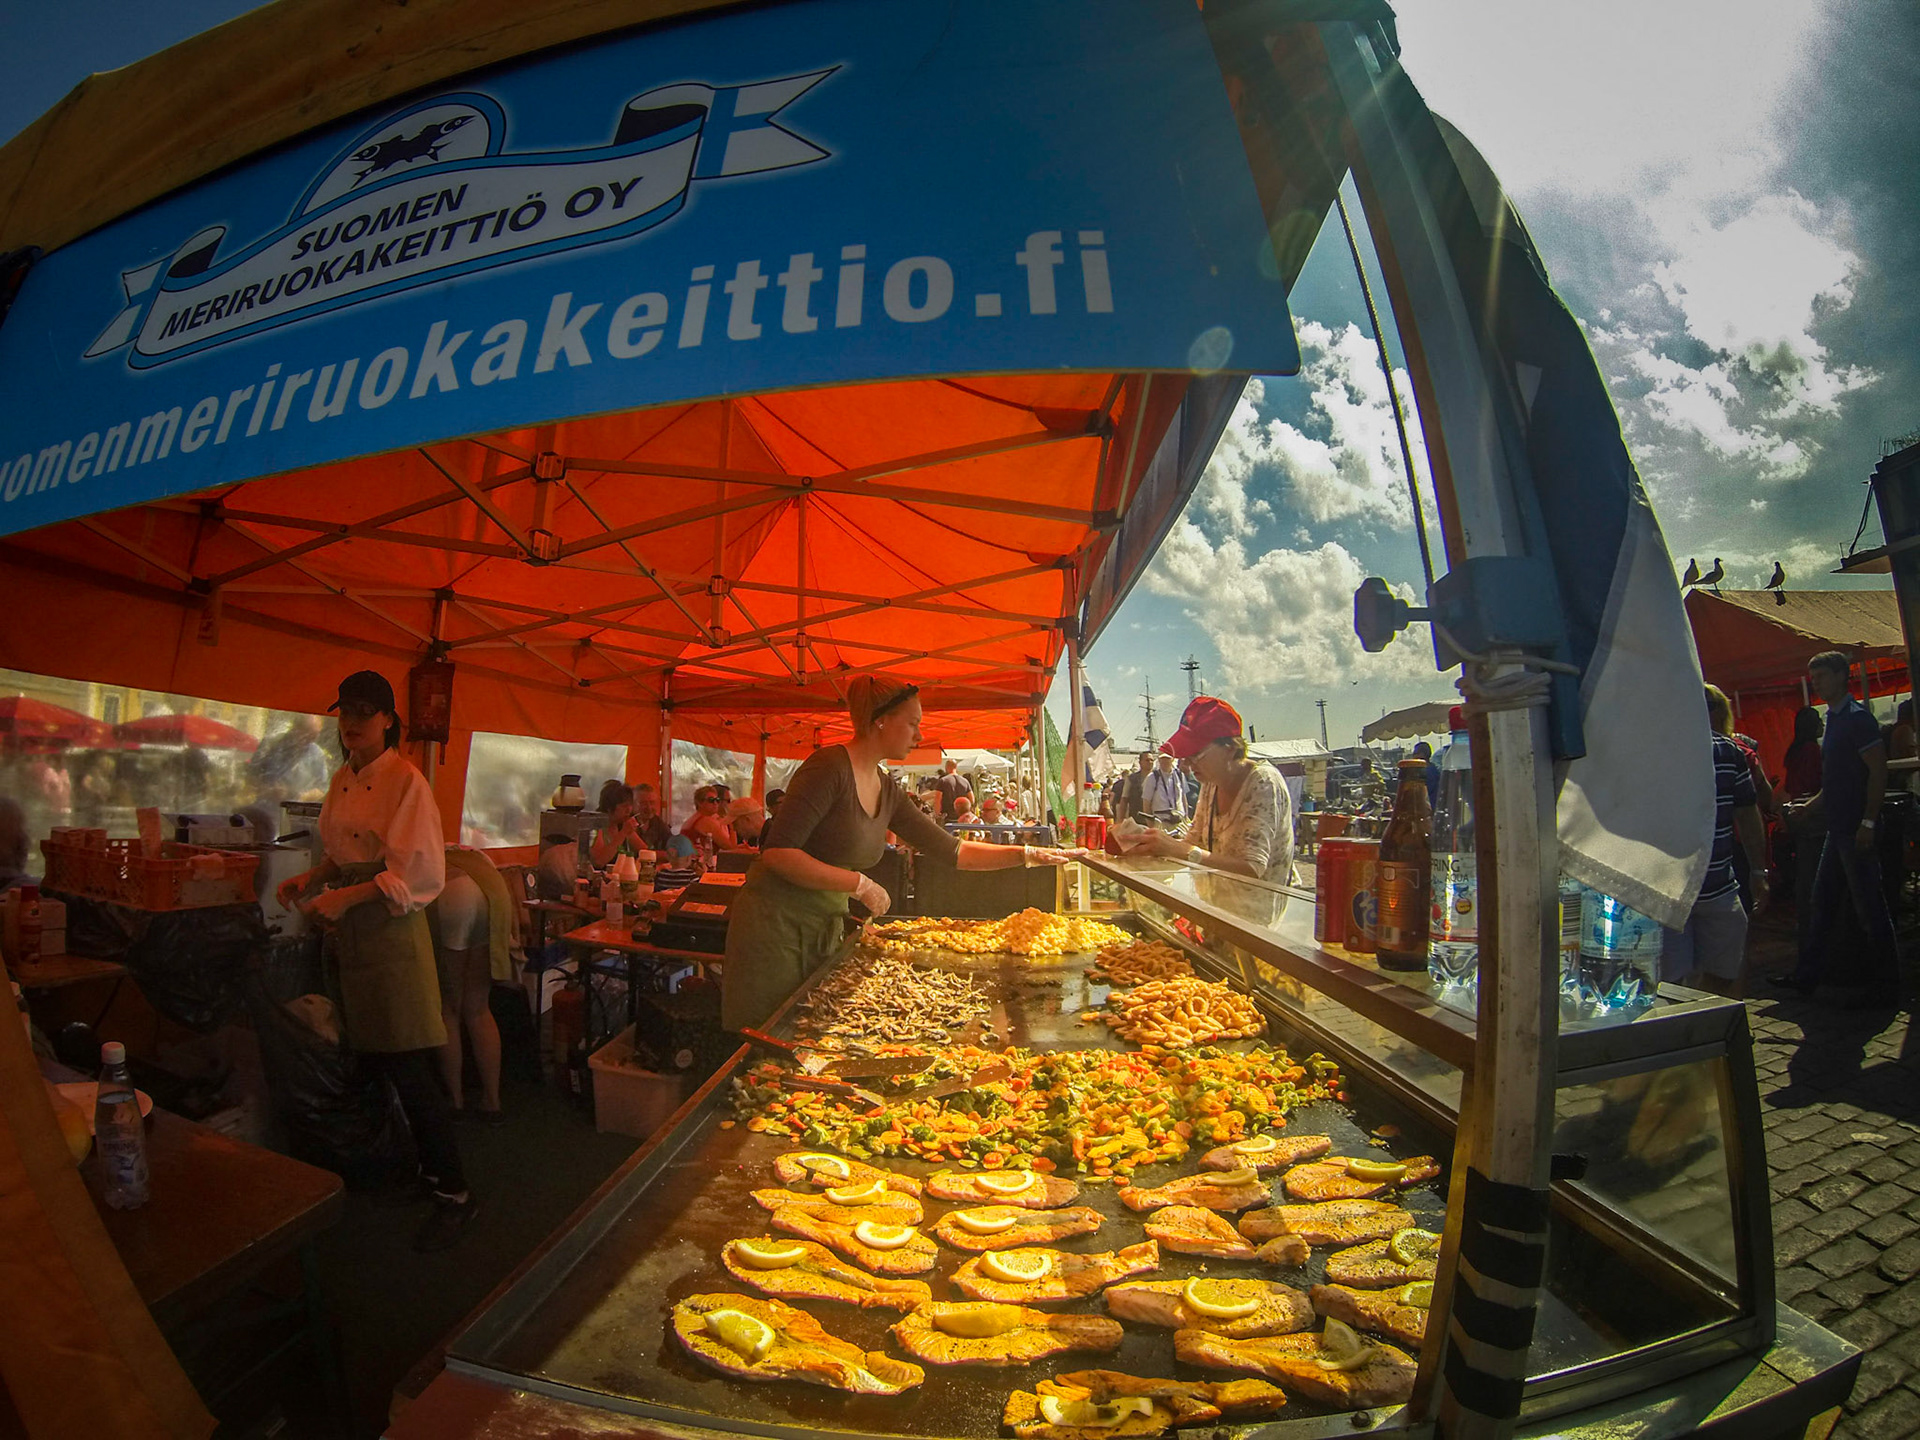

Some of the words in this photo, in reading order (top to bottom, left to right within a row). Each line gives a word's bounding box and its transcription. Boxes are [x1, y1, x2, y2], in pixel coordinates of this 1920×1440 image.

[158, 192, 547, 341] MERIRUOKAKEITTIÖ
[564, 176, 643, 218] OY
[291, 183, 468, 261] SUOMEN
